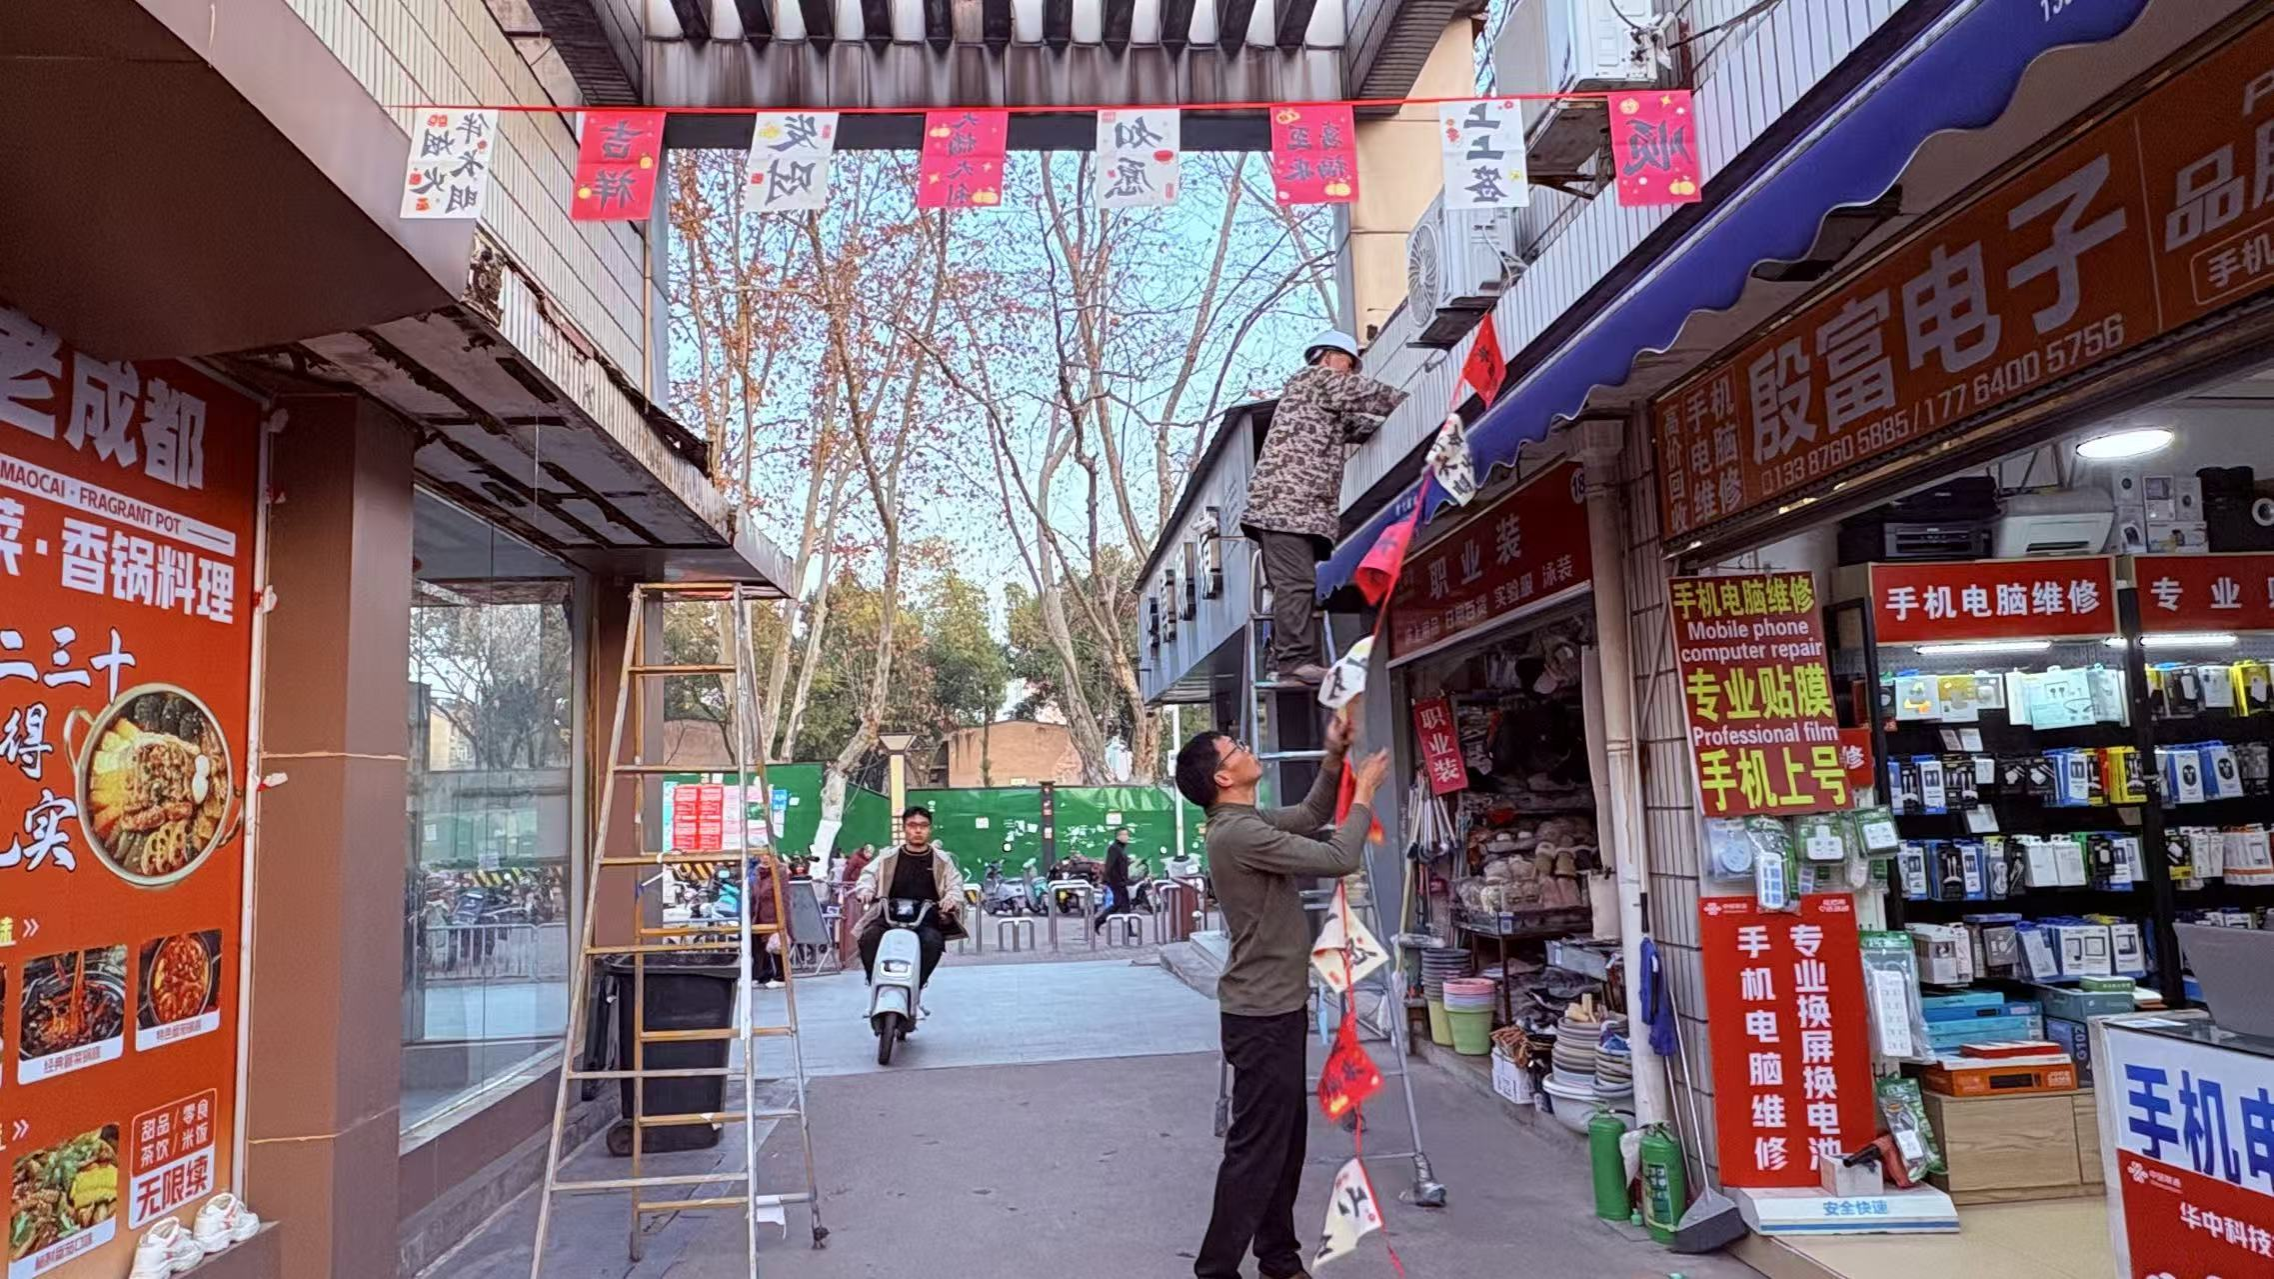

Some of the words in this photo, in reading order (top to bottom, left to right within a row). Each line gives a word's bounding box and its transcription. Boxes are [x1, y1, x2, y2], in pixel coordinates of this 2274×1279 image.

[1686, 376, 1735, 433] 手机
[1807, 434, 1854, 477] 8760
[1974, 350, 2040, 404] 6400
[2046, 312, 2126, 373] 5756
[1664, 405, 1689, 535] 高价回收
[1690, 423, 1739, 475] 电脑
[0, 460, 66, 499] MAOCAI
[79, 487, 155, 528] FRAGRANT
[155, 510, 182, 536] POT
[1693, 468, 1743, 524] 维修
[1428, 512, 1522, 600] 职业装
[1673, 576, 1815, 620] 手机电脑维修
[1885, 579, 2100, 622] 手机电脑维修
[1681, 643, 1766, 665] computer
[1770, 637, 1823, 661] repair
[1687, 619, 1749, 641] Mobile
[1753, 618, 1809, 642] phone
[1686, 662, 1834, 723] 专业贴膜
[1420, 705, 1460, 783] 职业装
[1692, 722, 1800, 747] Professional
[1802, 721, 1839, 742] film
[1699, 745, 1847, 812] 手机上号
[1737, 925, 1789, 1172] 手机电脑维修
[137, 1154, 208, 1222] 无限续
[1822, 1200, 1888, 1216] 安全快速
[2179, 1201, 2274, 1259] 华中科技
